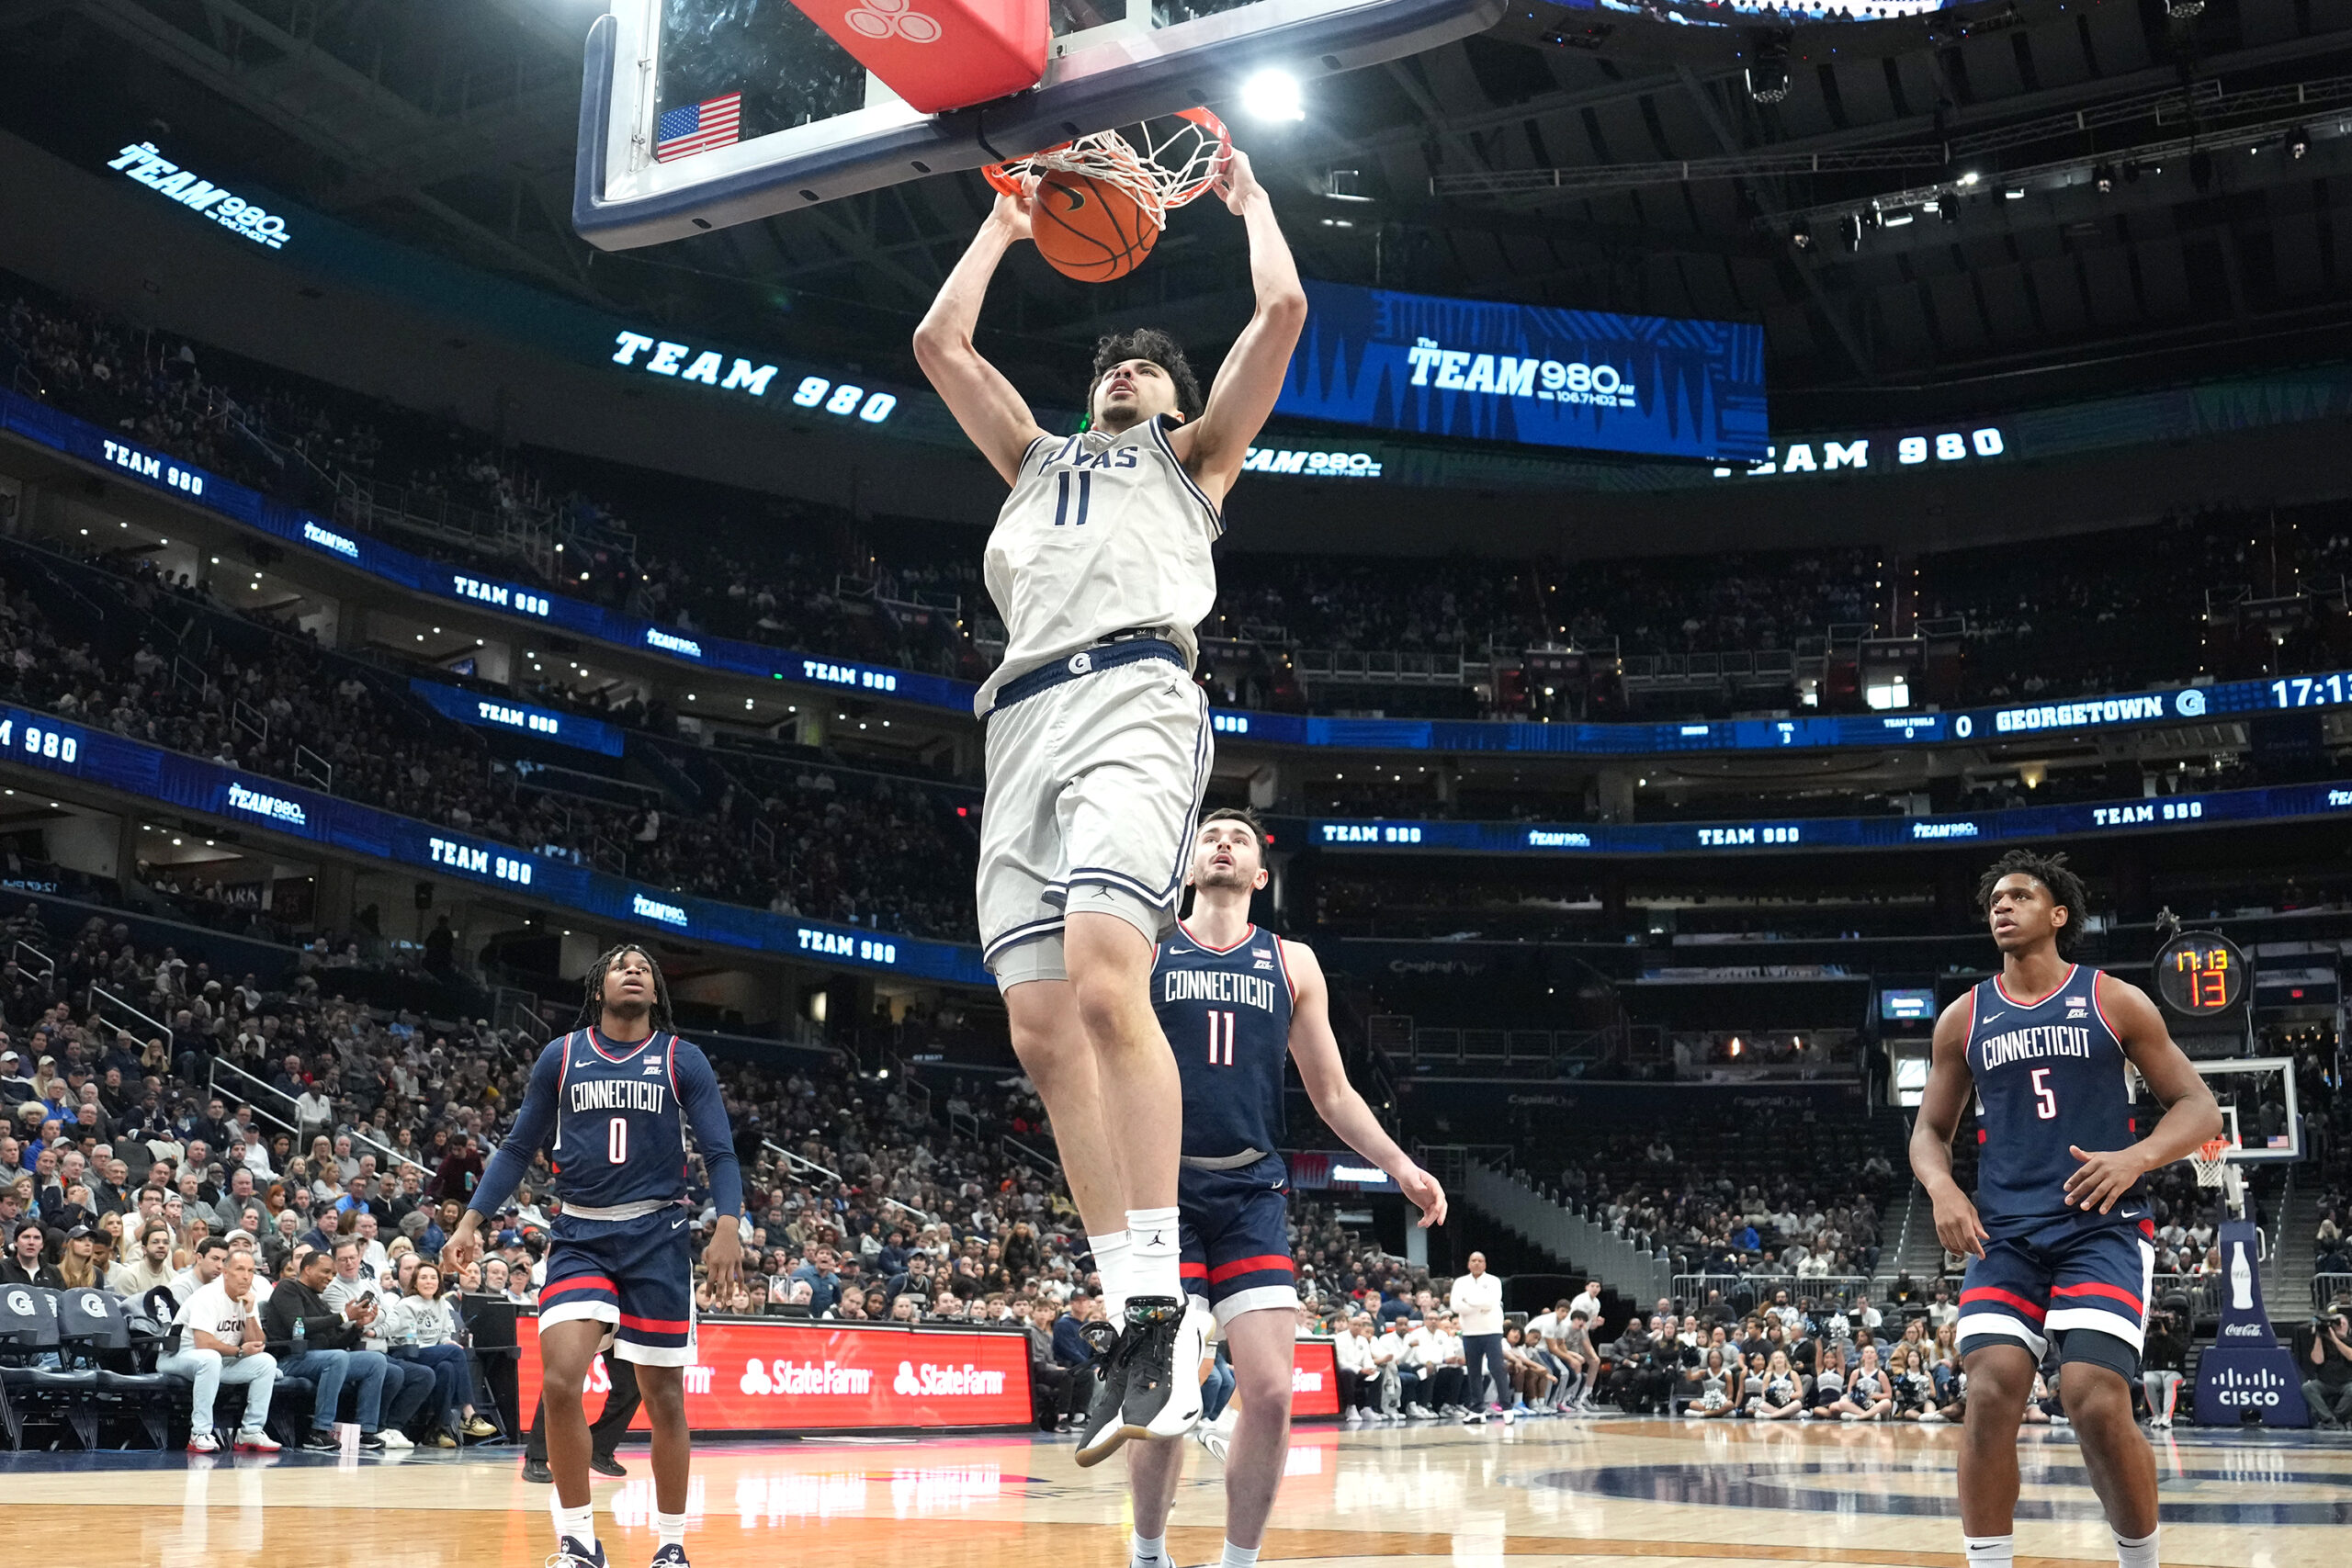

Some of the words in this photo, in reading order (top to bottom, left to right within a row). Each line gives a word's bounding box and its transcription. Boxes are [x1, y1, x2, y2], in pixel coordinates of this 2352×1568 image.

[107, 143, 231, 211] TEAM
[217, 196, 285, 235] 980
[1417, 336, 1438, 349] The
[612, 330, 778, 396] TEAM
[792, 376, 897, 423] 980
[1408, 346, 1540, 397] TEAM
[1540, 360, 1621, 394] 980
[1617, 384, 1635, 395] AM
[1556, 390, 1617, 407] 106.7HD2
[1308, 452, 1372, 469] 980
[1898, 427, 2004, 464] 980
[103, 439, 161, 479] TEAM
[167, 466, 203, 495] 980
[1054, 470, 1091, 526] 11
[304, 524, 337, 548] TEAM
[454, 575, 508, 605] TEAM
[514, 592, 548, 616] 980
[647, 630, 679, 650] TEAM
[803, 660, 856, 684] TEAM
[863, 671, 896, 692] 980
[479, 702, 524, 727] TEAM
[1956, 716, 1972, 738] 0
[1996, 695, 2163, 732] GEORGETOWN
[2272, 674, 2352, 708] 17:1
[26, 727, 76, 763] 980
[1905, 727, 1914, 739] 0
[229, 786, 275, 816] TEAM
[273, 798, 301, 818] 980
[2093, 805, 2154, 825] TEAM
[2163, 802, 2202, 819] 980
[1323, 825, 1378, 841] TEAM
[1385, 827, 1421, 842] 980
[1529, 831, 1565, 845] TEAM
[1698, 828, 1755, 845] TEAM
[1763, 827, 1799, 843] 980
[1913, 824, 1951, 838] TEAM
[429, 837, 489, 874] TEAM
[496, 856, 531, 885] 980
[633, 897, 666, 919] TEAM
[797, 929, 854, 956] TEAM
[861, 940, 895, 964] 980
[2178, 949, 2228, 972] 17:13
[1165, 970, 1275, 1013] CONNECTICUT
[2191, 970, 2226, 1007] 13
[1207, 1010, 1235, 1066] 11
[1983, 1025, 2090, 1071] CONNECTICUT
[571, 1079, 665, 1114] CONNECTICUT
[2031, 1067, 2056, 1120] 5
[609, 1117, 627, 1164] 0
